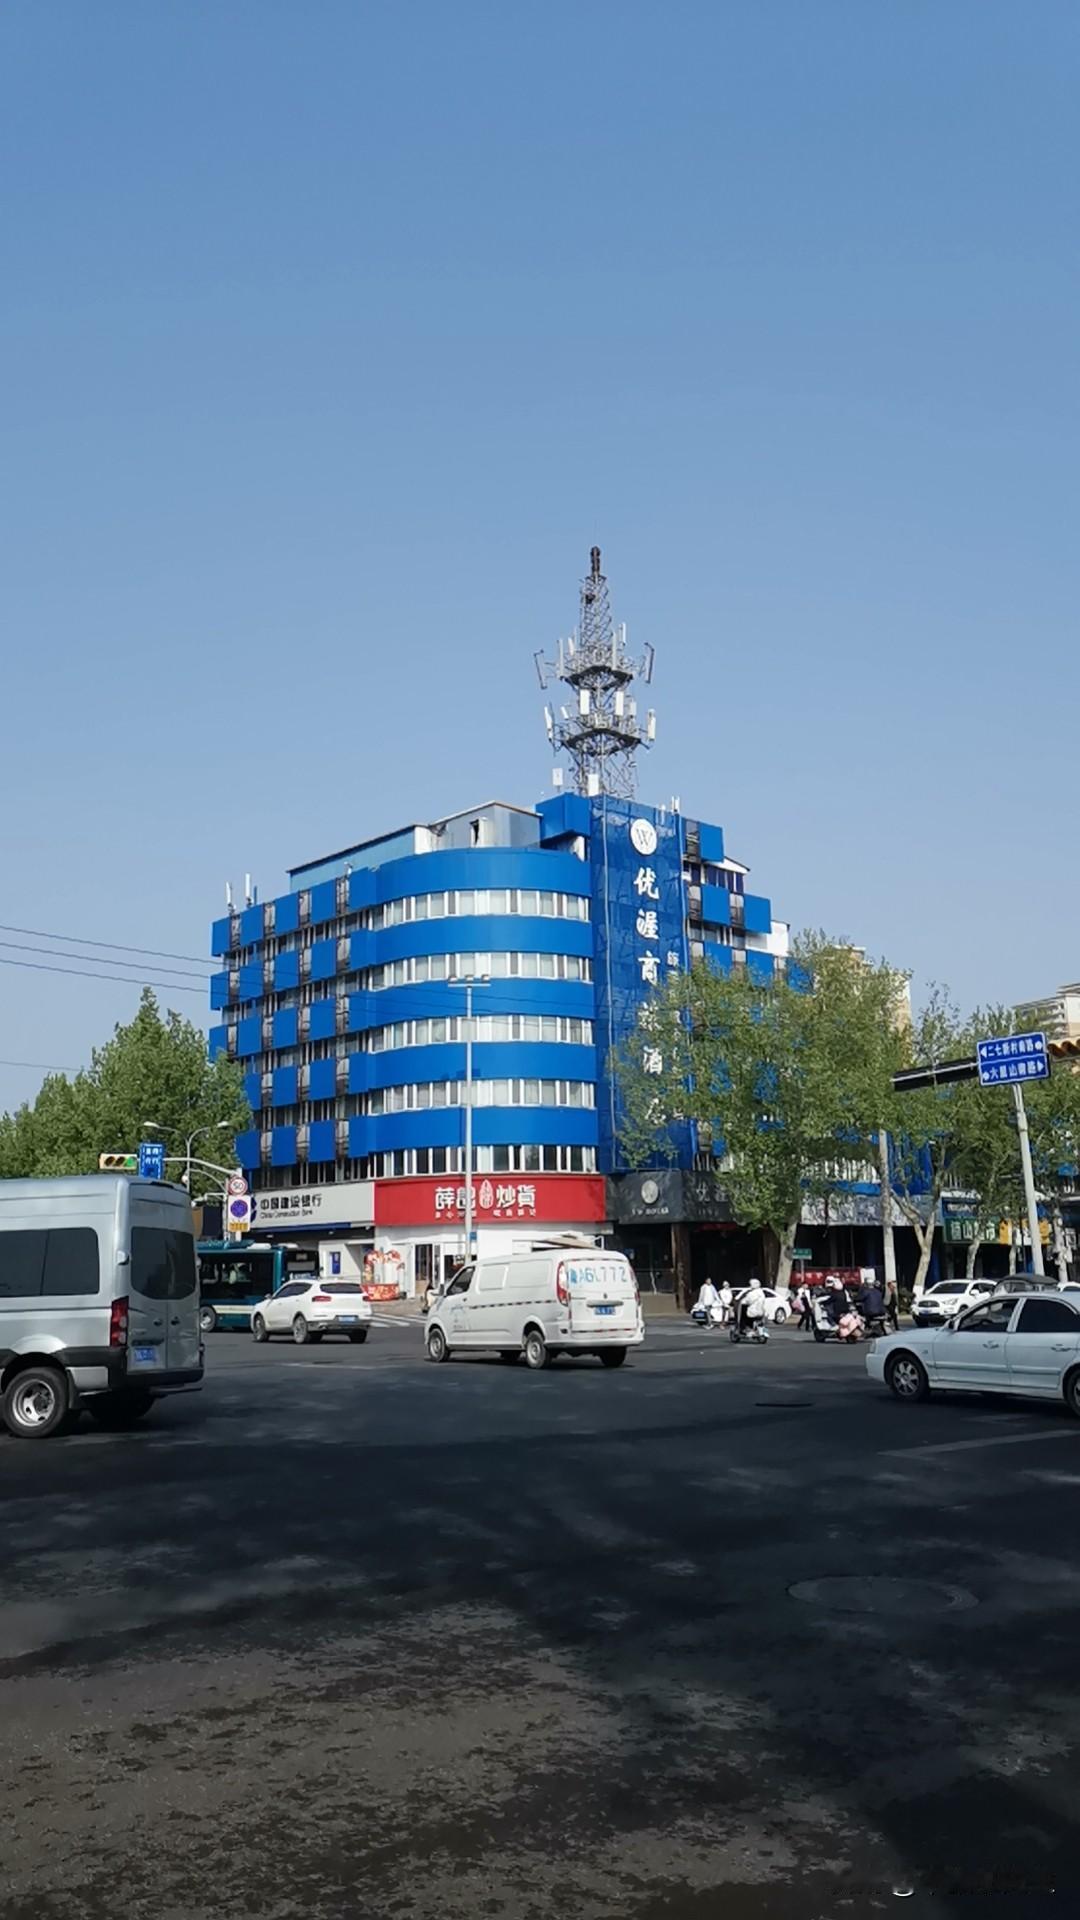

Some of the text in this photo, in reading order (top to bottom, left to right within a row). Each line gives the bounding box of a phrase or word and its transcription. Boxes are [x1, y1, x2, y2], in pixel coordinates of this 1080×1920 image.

[260, 1193, 322, 1211] 中国建设银行
